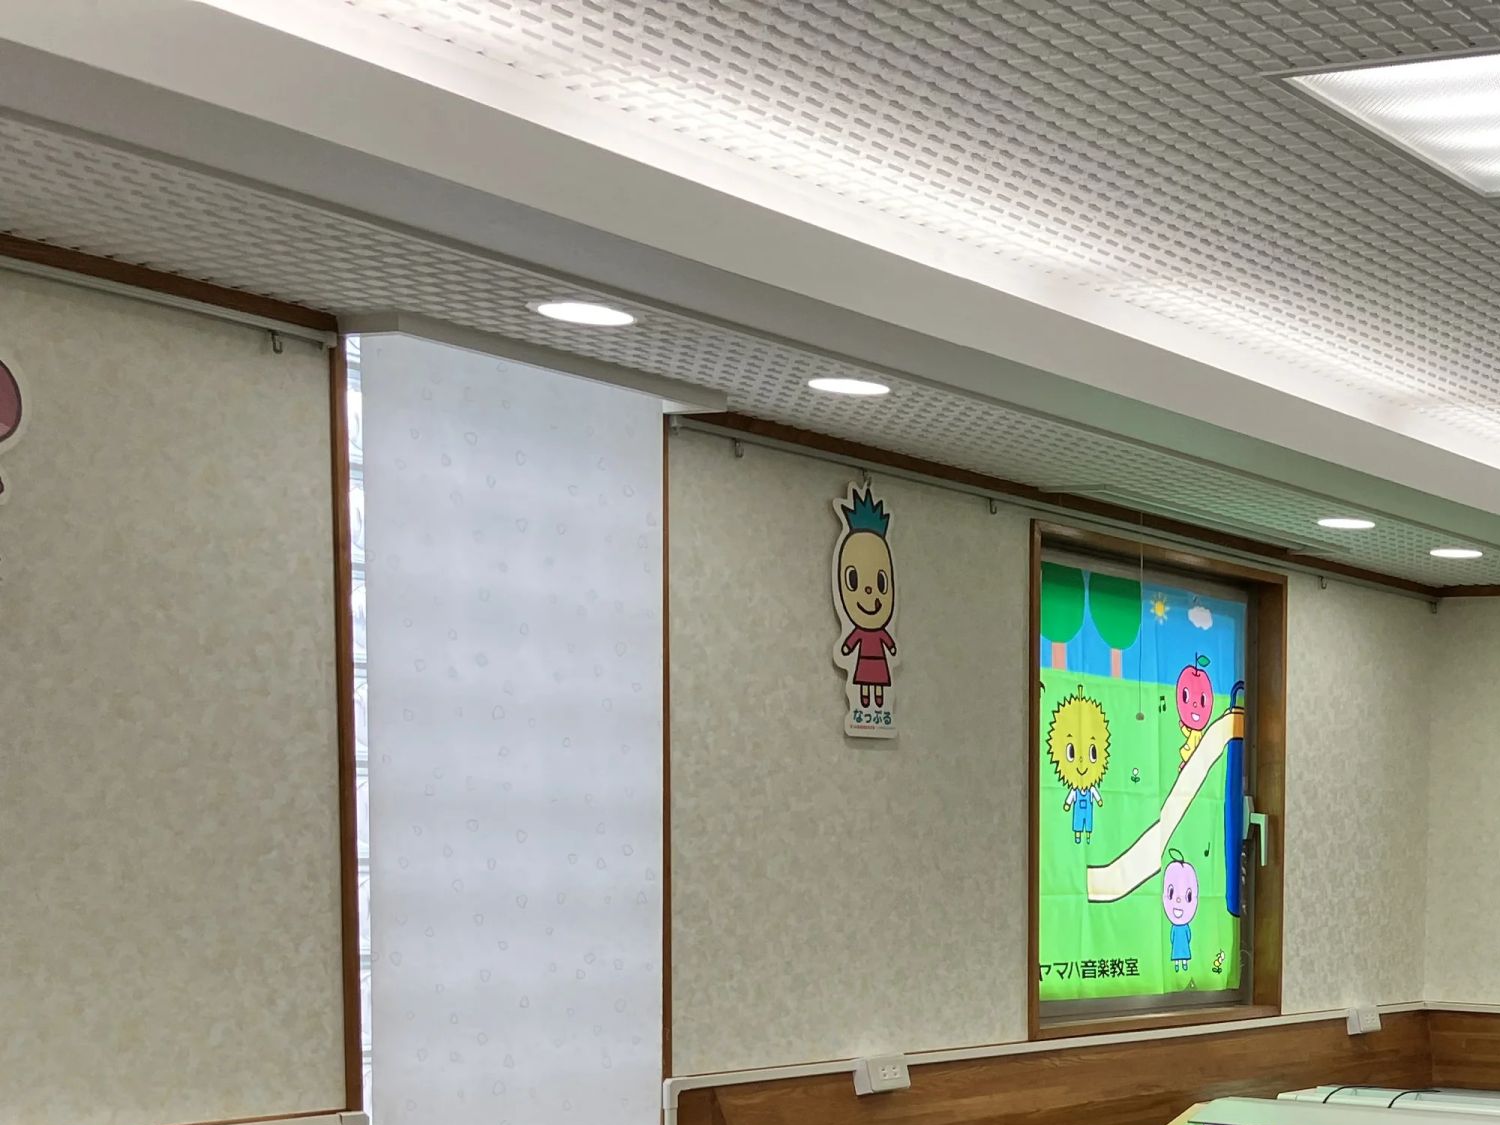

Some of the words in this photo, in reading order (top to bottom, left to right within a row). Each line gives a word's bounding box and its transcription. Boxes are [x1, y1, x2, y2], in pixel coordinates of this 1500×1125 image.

[1039, 958, 1140, 981] ヤマハ音楽教室
